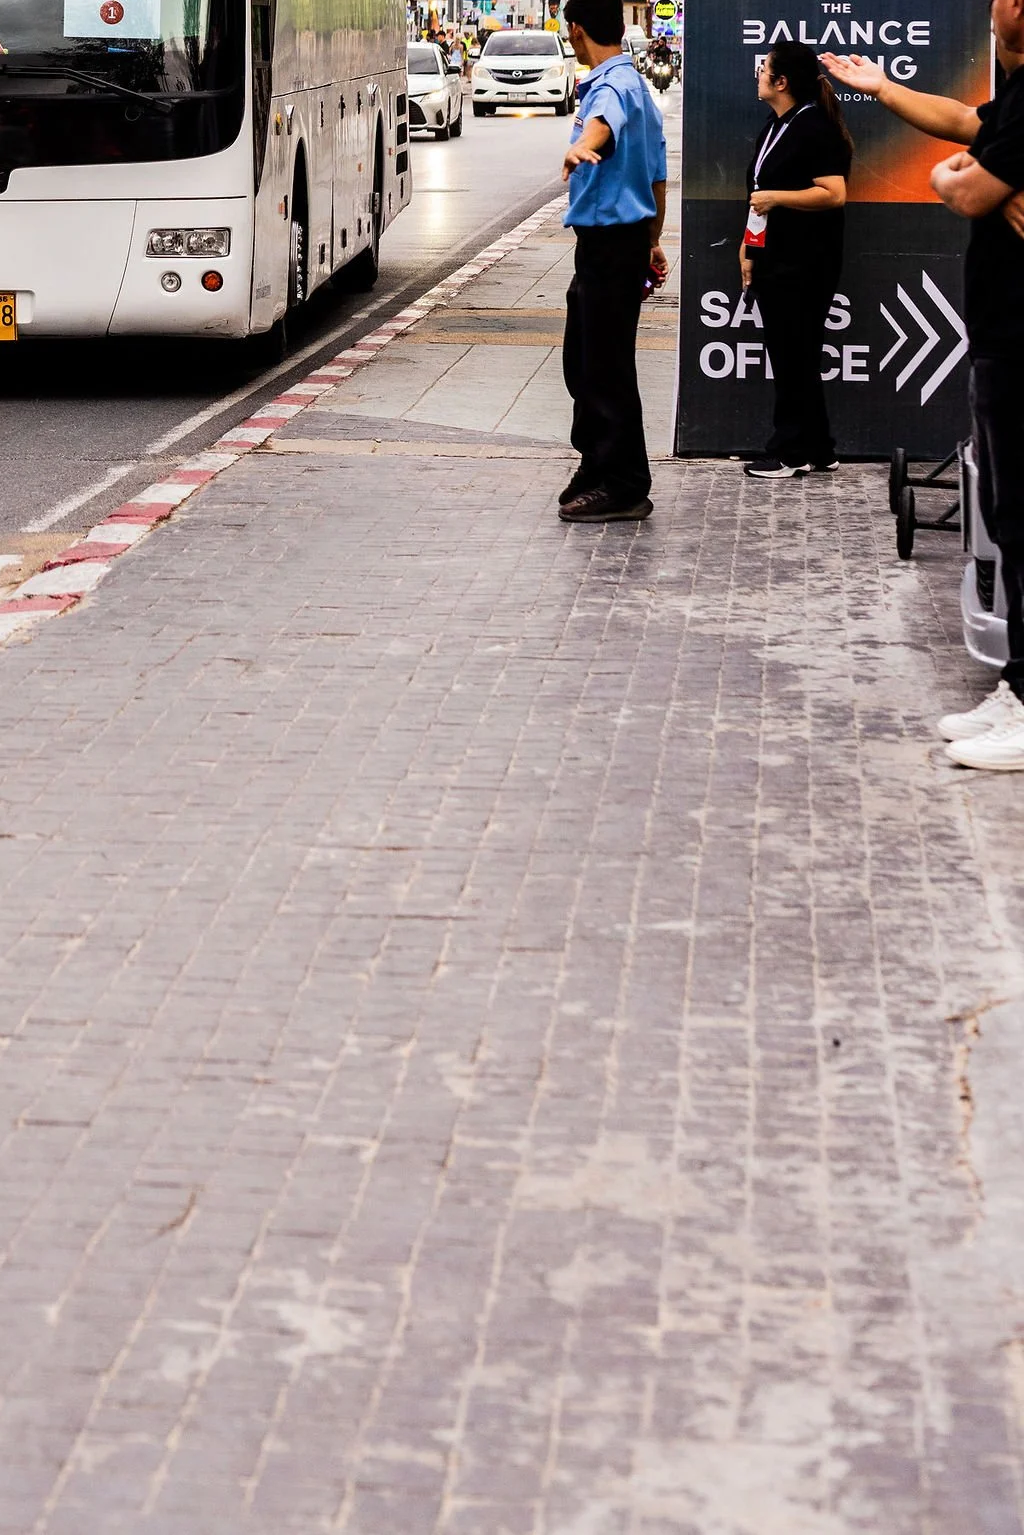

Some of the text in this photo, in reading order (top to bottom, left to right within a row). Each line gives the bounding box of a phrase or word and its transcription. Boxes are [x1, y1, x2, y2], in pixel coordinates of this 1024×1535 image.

[821, 3, 852, 13] THE
[742, 19, 931, 46] BALANCE
[699, 290, 852, 331] SAS
[699, 341, 870, 382] OFCE
